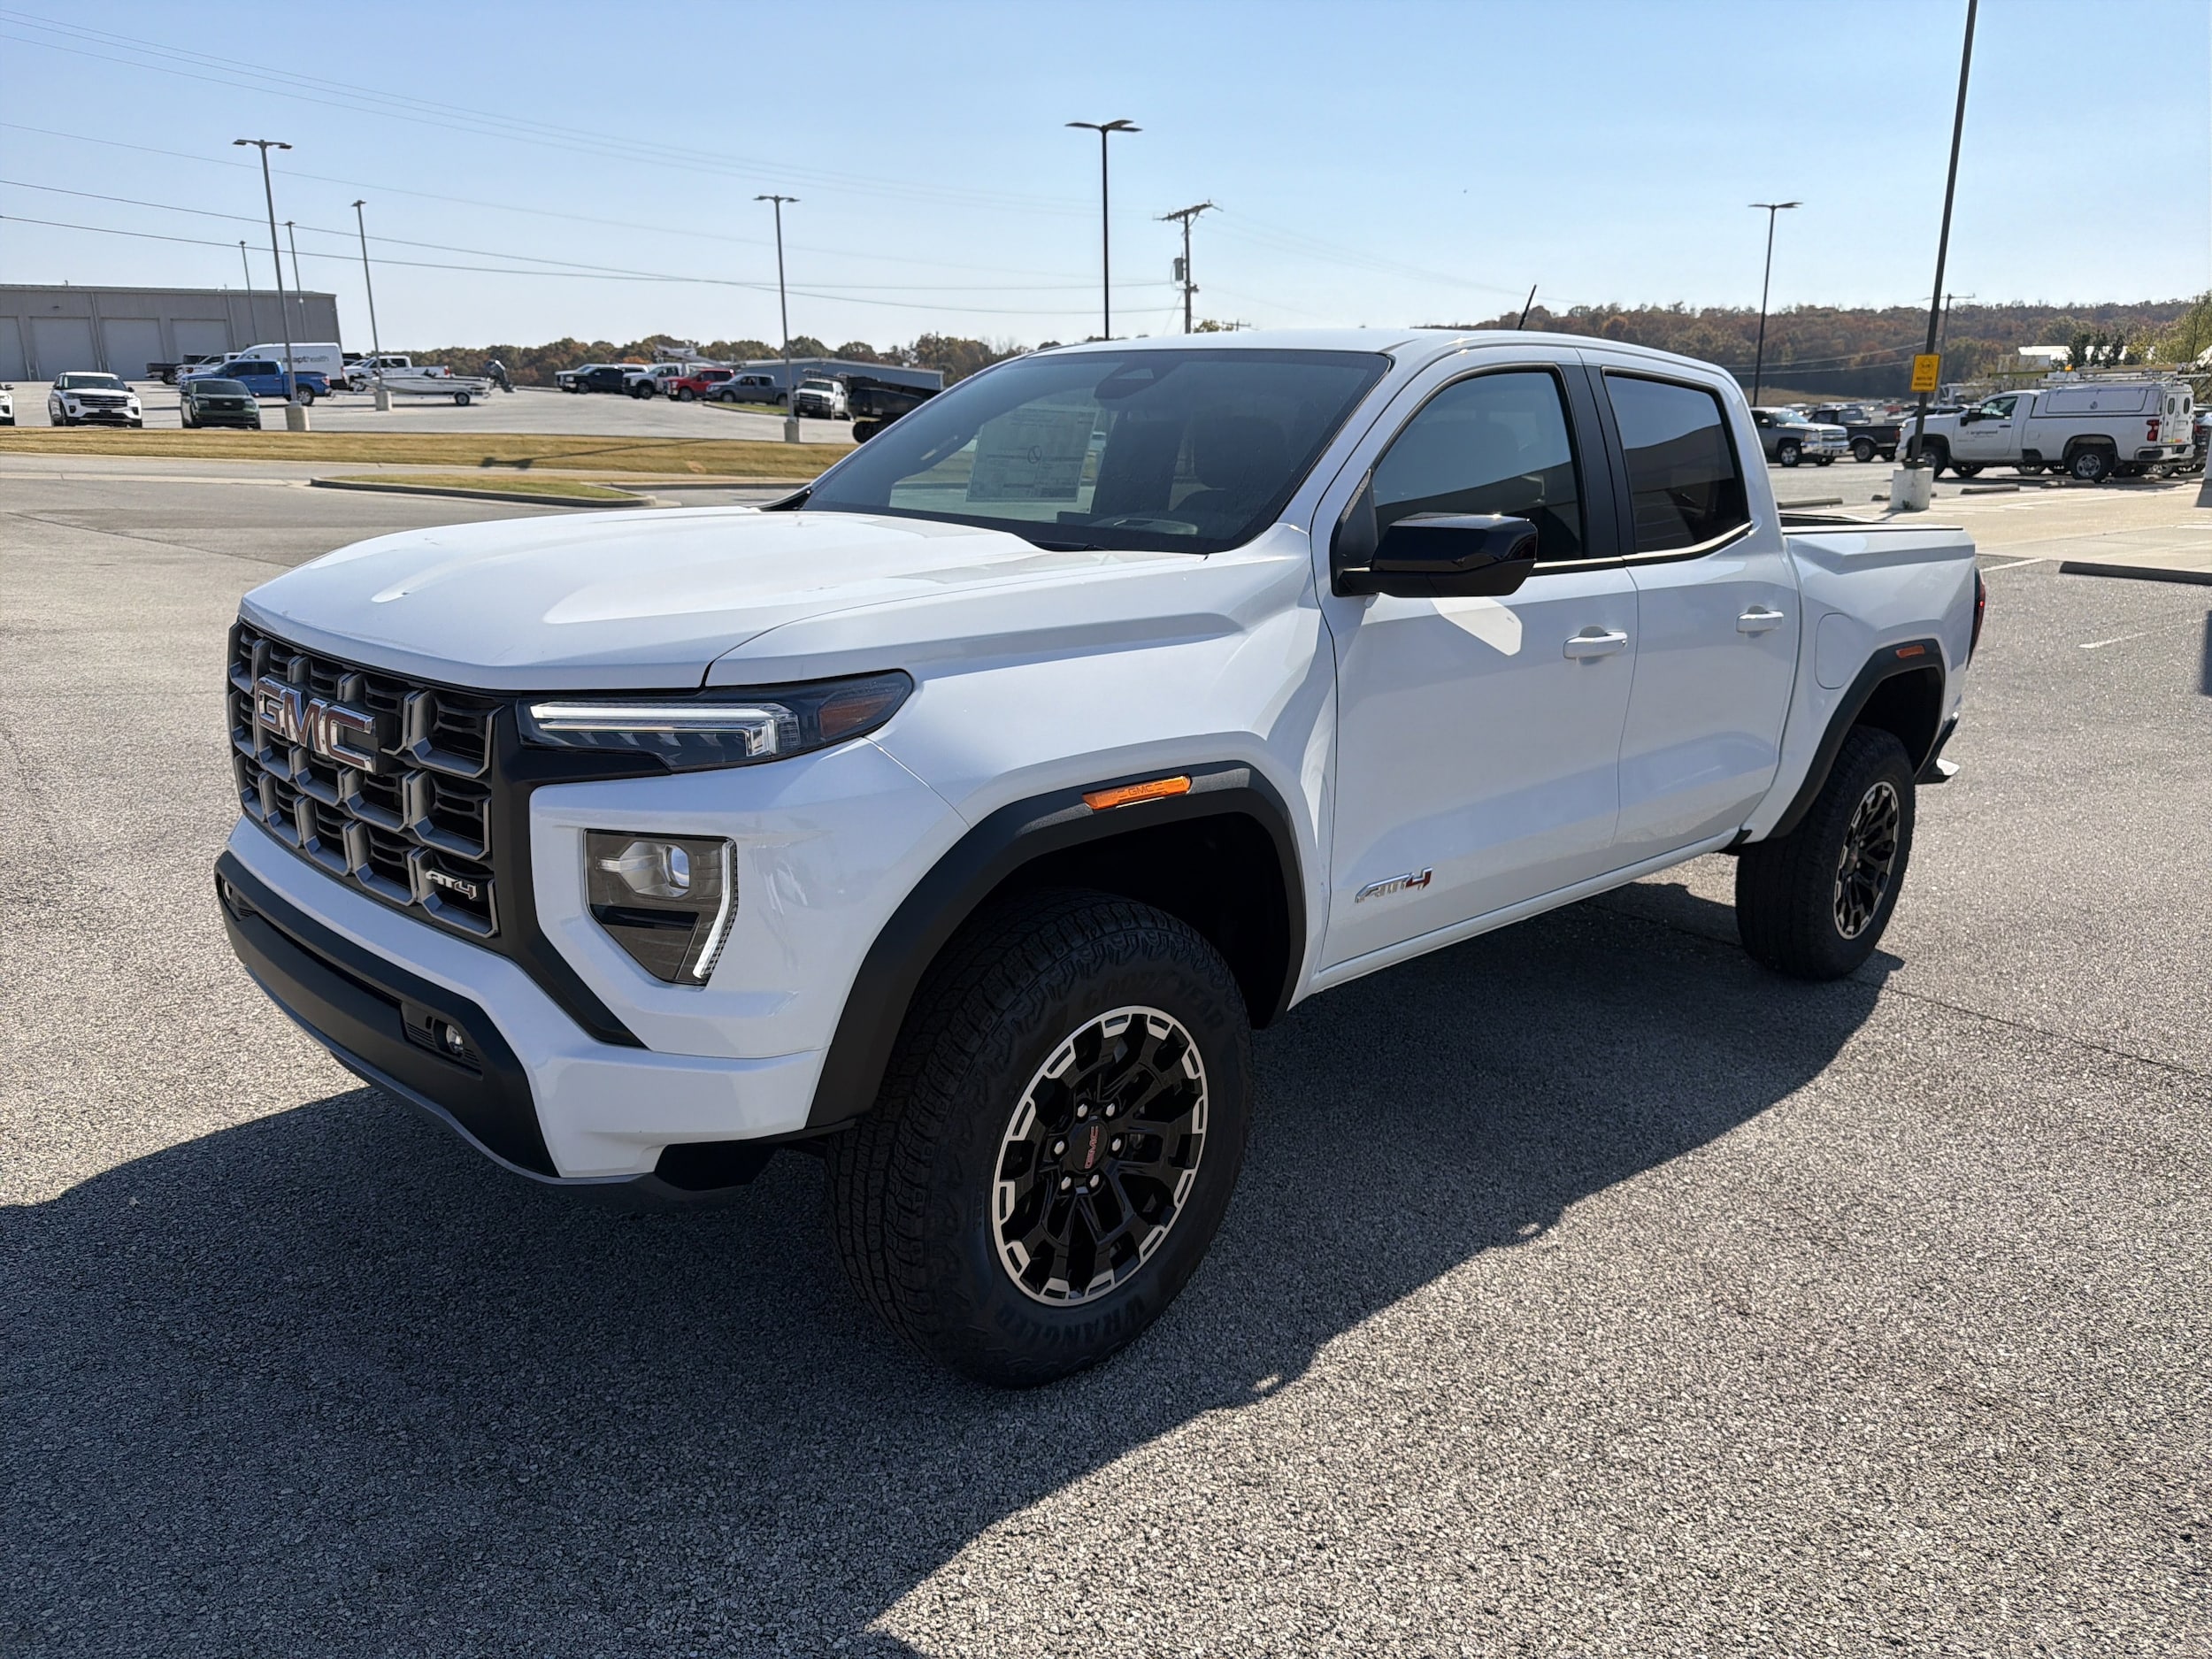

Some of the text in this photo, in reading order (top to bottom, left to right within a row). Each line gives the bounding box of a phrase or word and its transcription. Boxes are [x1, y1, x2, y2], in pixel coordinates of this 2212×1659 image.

[255, 677, 376, 773] GMC
[1128, 784, 1155, 796] GMC
[425, 870, 477, 901] AT4
[1355, 866, 1433, 904] AT4
[1084, 1125, 1099, 1169] GMC
